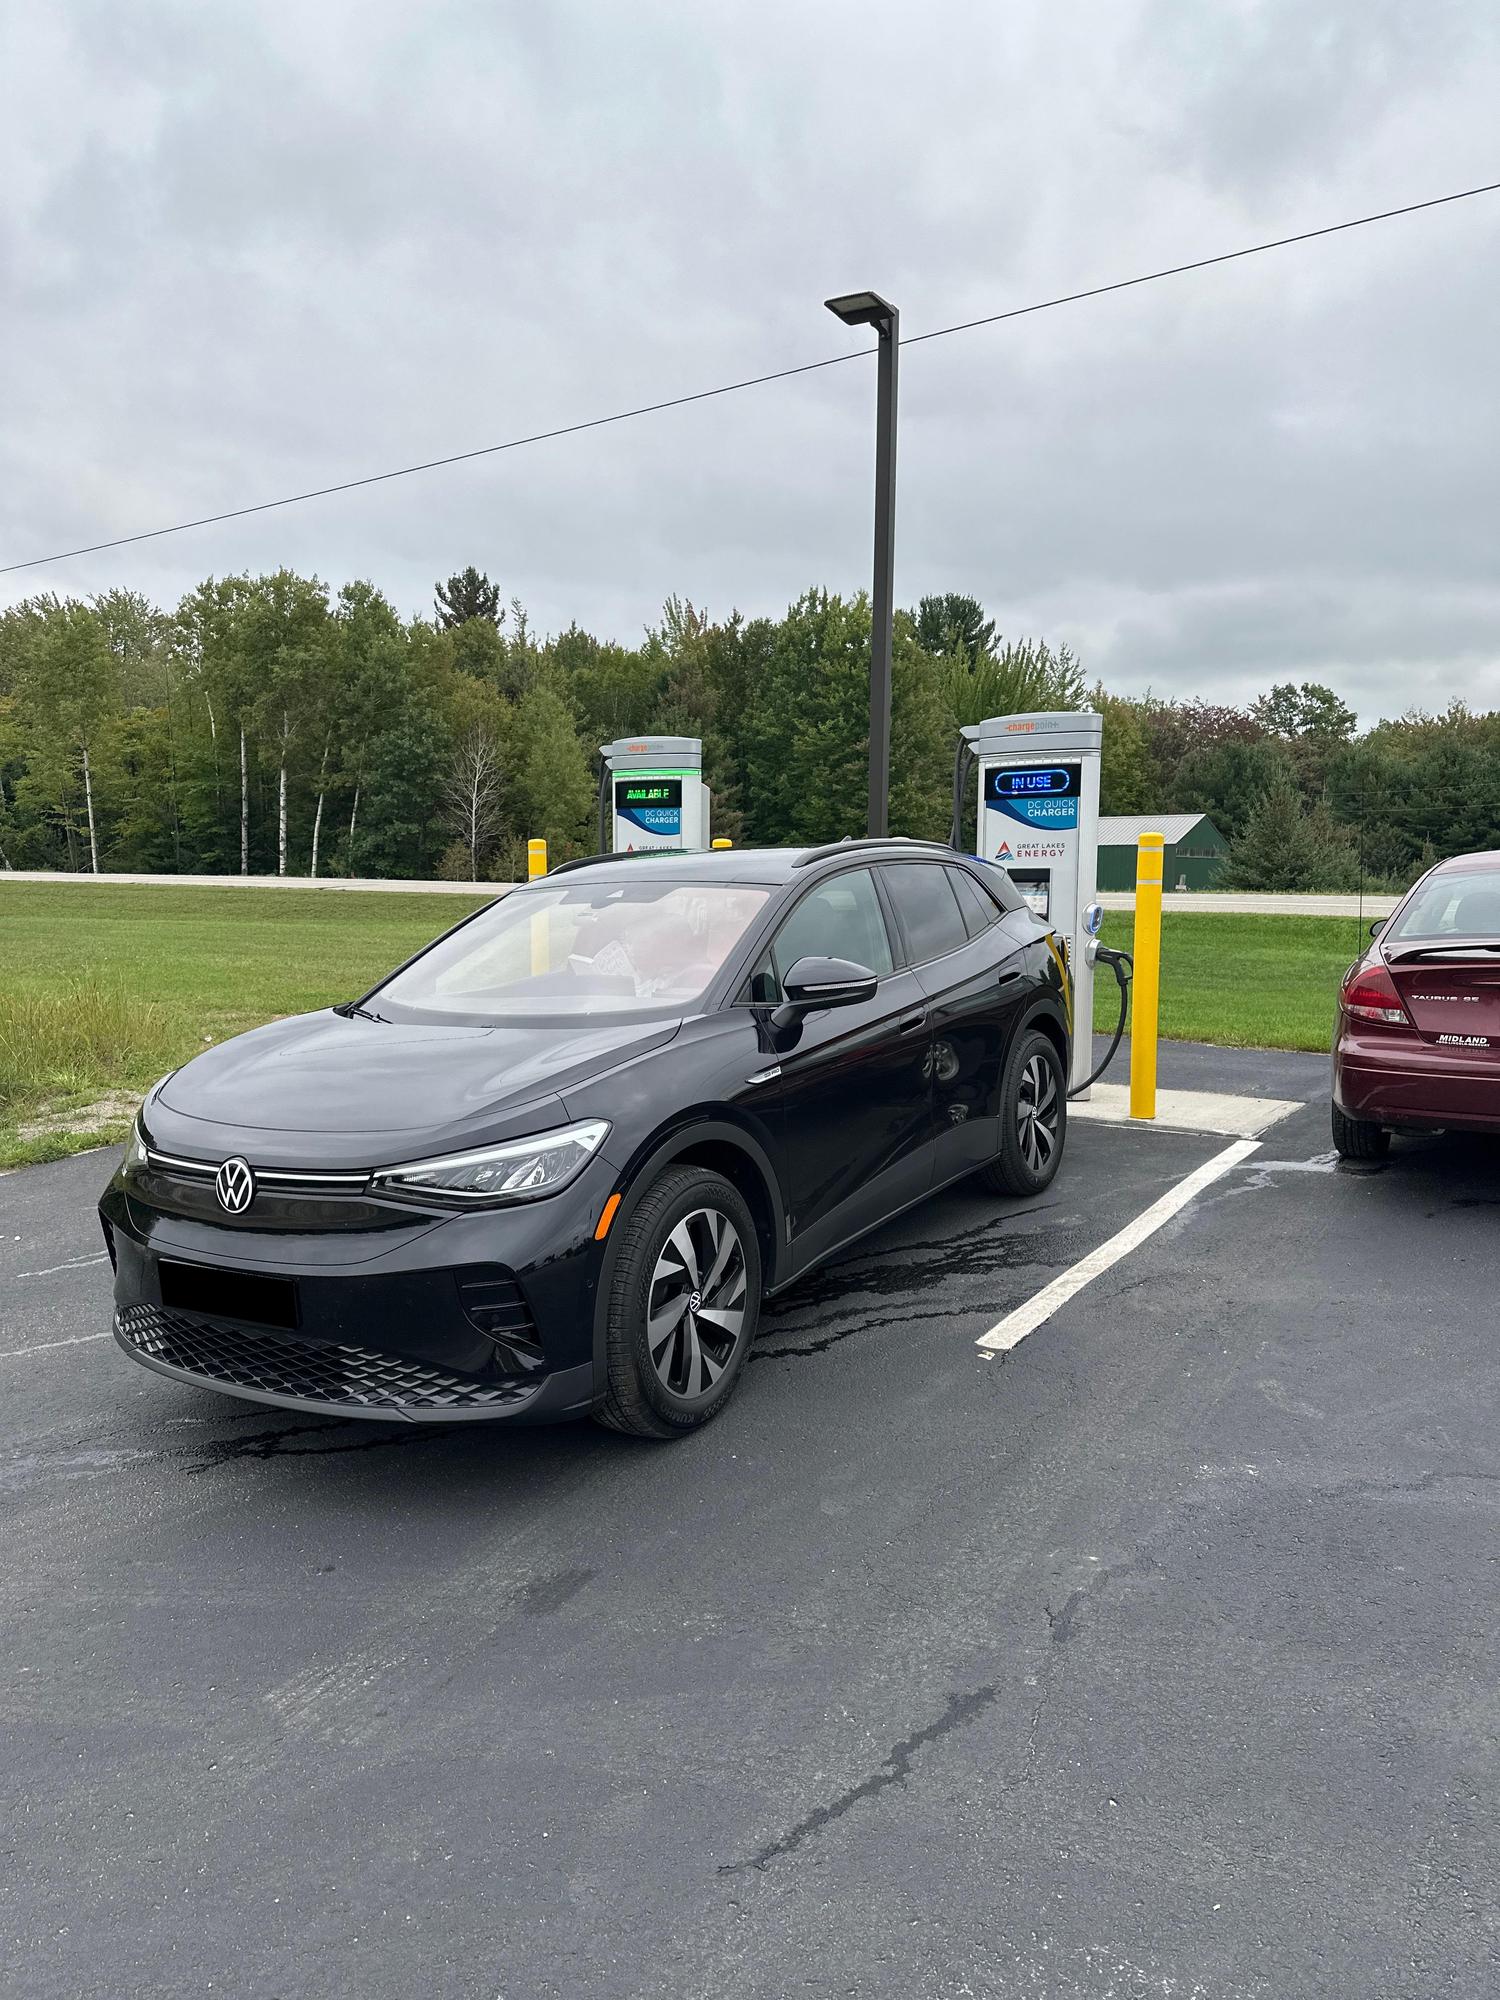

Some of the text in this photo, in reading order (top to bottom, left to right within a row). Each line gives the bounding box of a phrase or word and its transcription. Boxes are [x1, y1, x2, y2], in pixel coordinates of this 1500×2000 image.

[1012, 775, 1052, 789] IN USE
[1027, 799, 1075, 809] DC QUICK
[1027, 807, 1075, 817] CHARGER
[645, 816, 679, 824] CHARGER
[1017, 849, 1065, 858] ENERGY
[1439, 1034, 1488, 1045] MIDLAND
[660, 1403, 696, 1424] KUMHO
